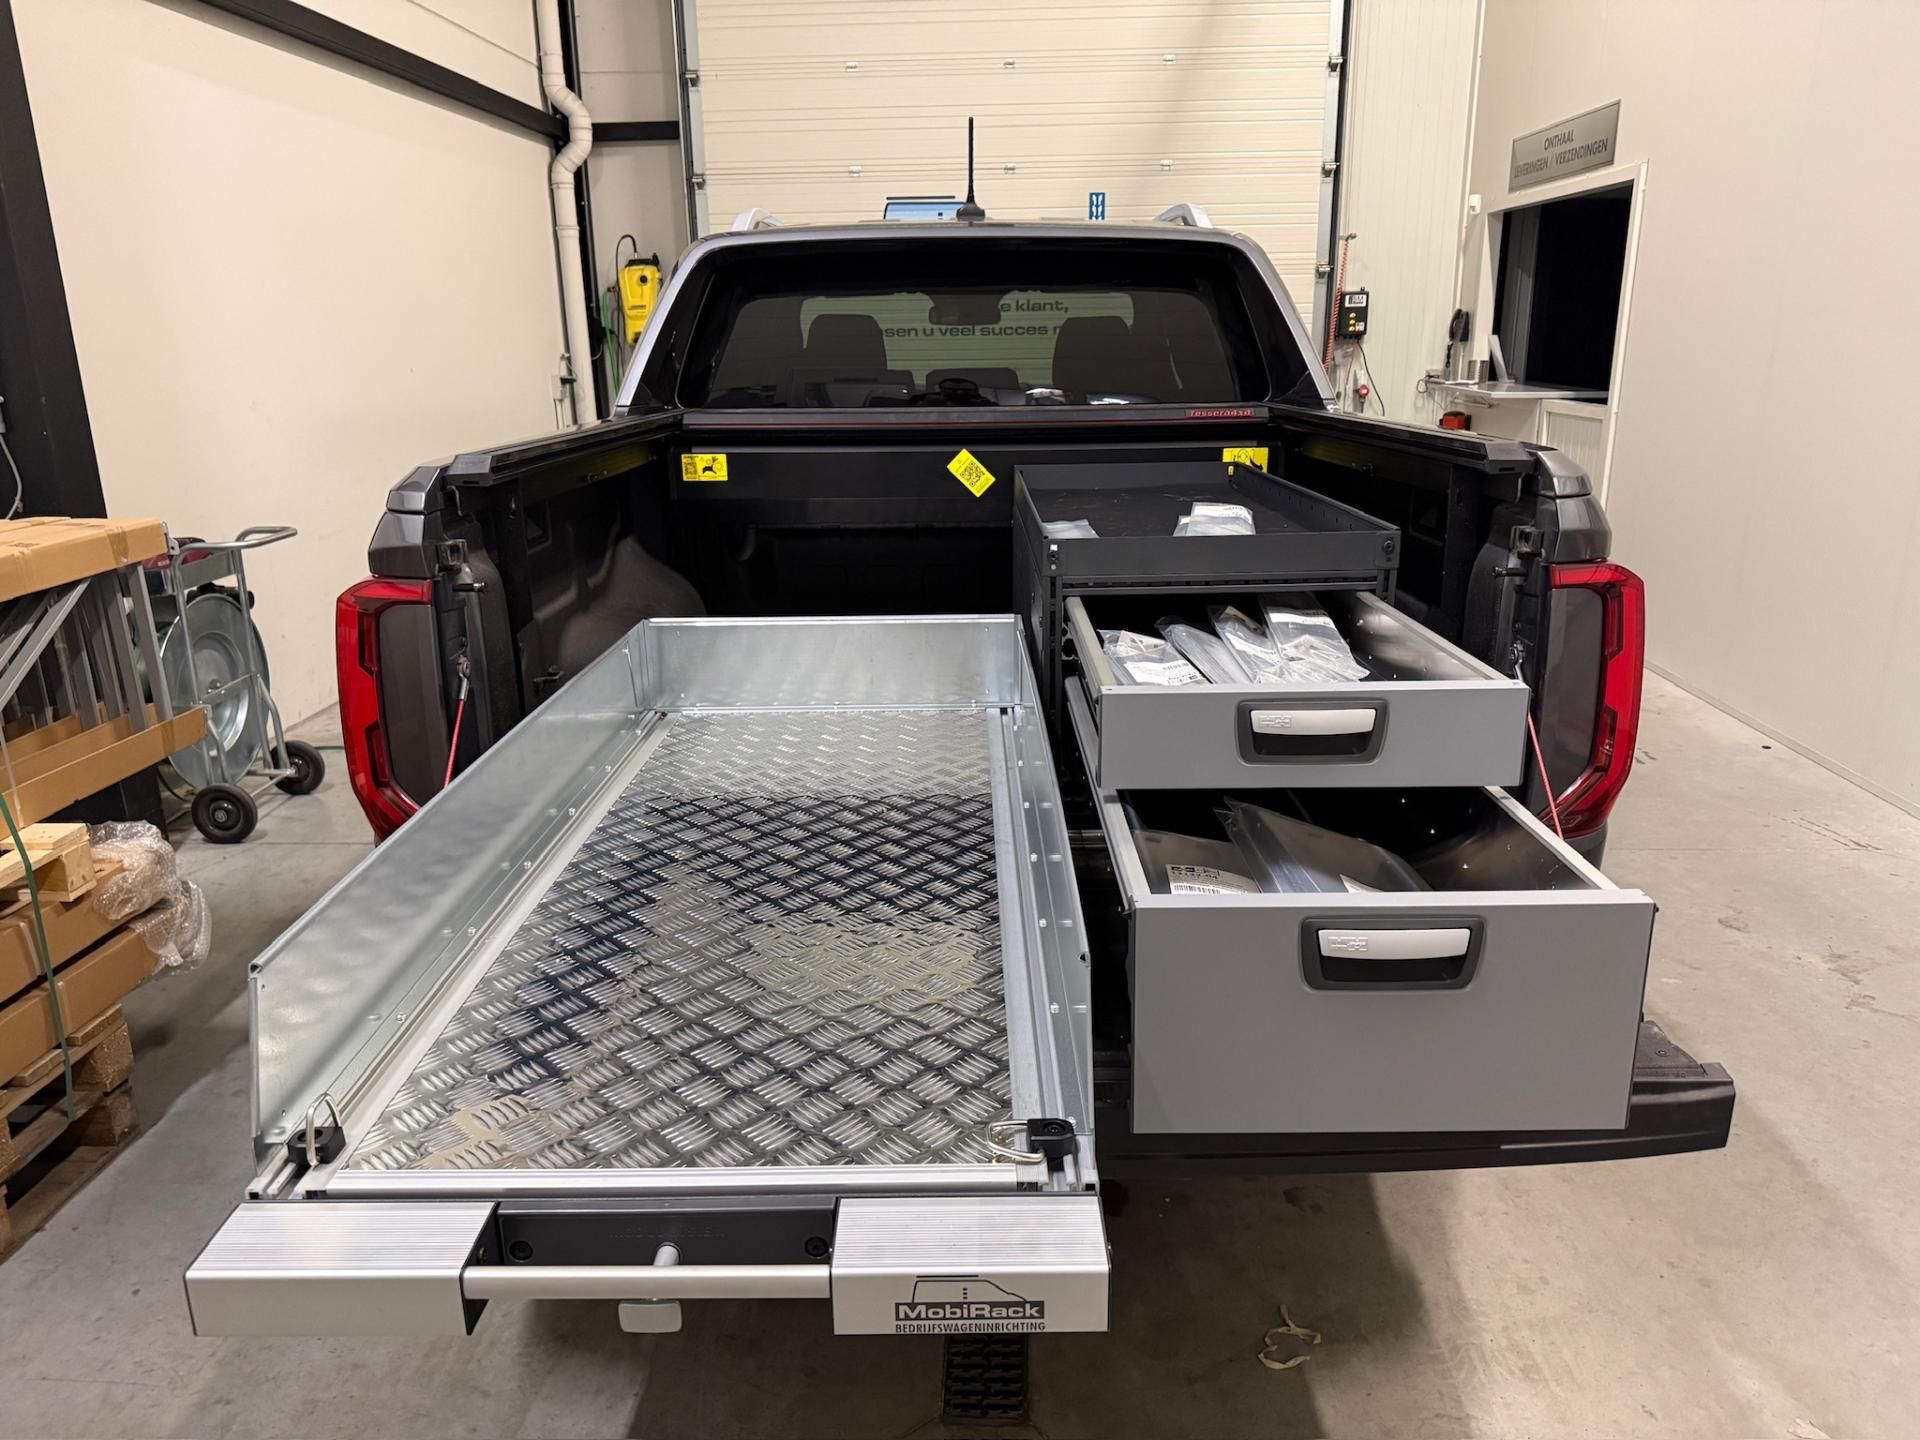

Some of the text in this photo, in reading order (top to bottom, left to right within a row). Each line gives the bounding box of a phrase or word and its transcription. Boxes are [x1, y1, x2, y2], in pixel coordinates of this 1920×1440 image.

[1544, 129, 1574, 151] ONTHAAL
[1555, 137, 1608, 165] VERZENDINGEN
[1016, 299, 1069, 313] klant,
[923, 327, 933, 336] u
[938, 324, 975, 336] veel
[980, 326, 1049, 336] succes
[898, 1303, 1041, 1319] MobiRack
[895, 1322, 1046, 1333] BEDRIJFSWAGENINRICHTING
